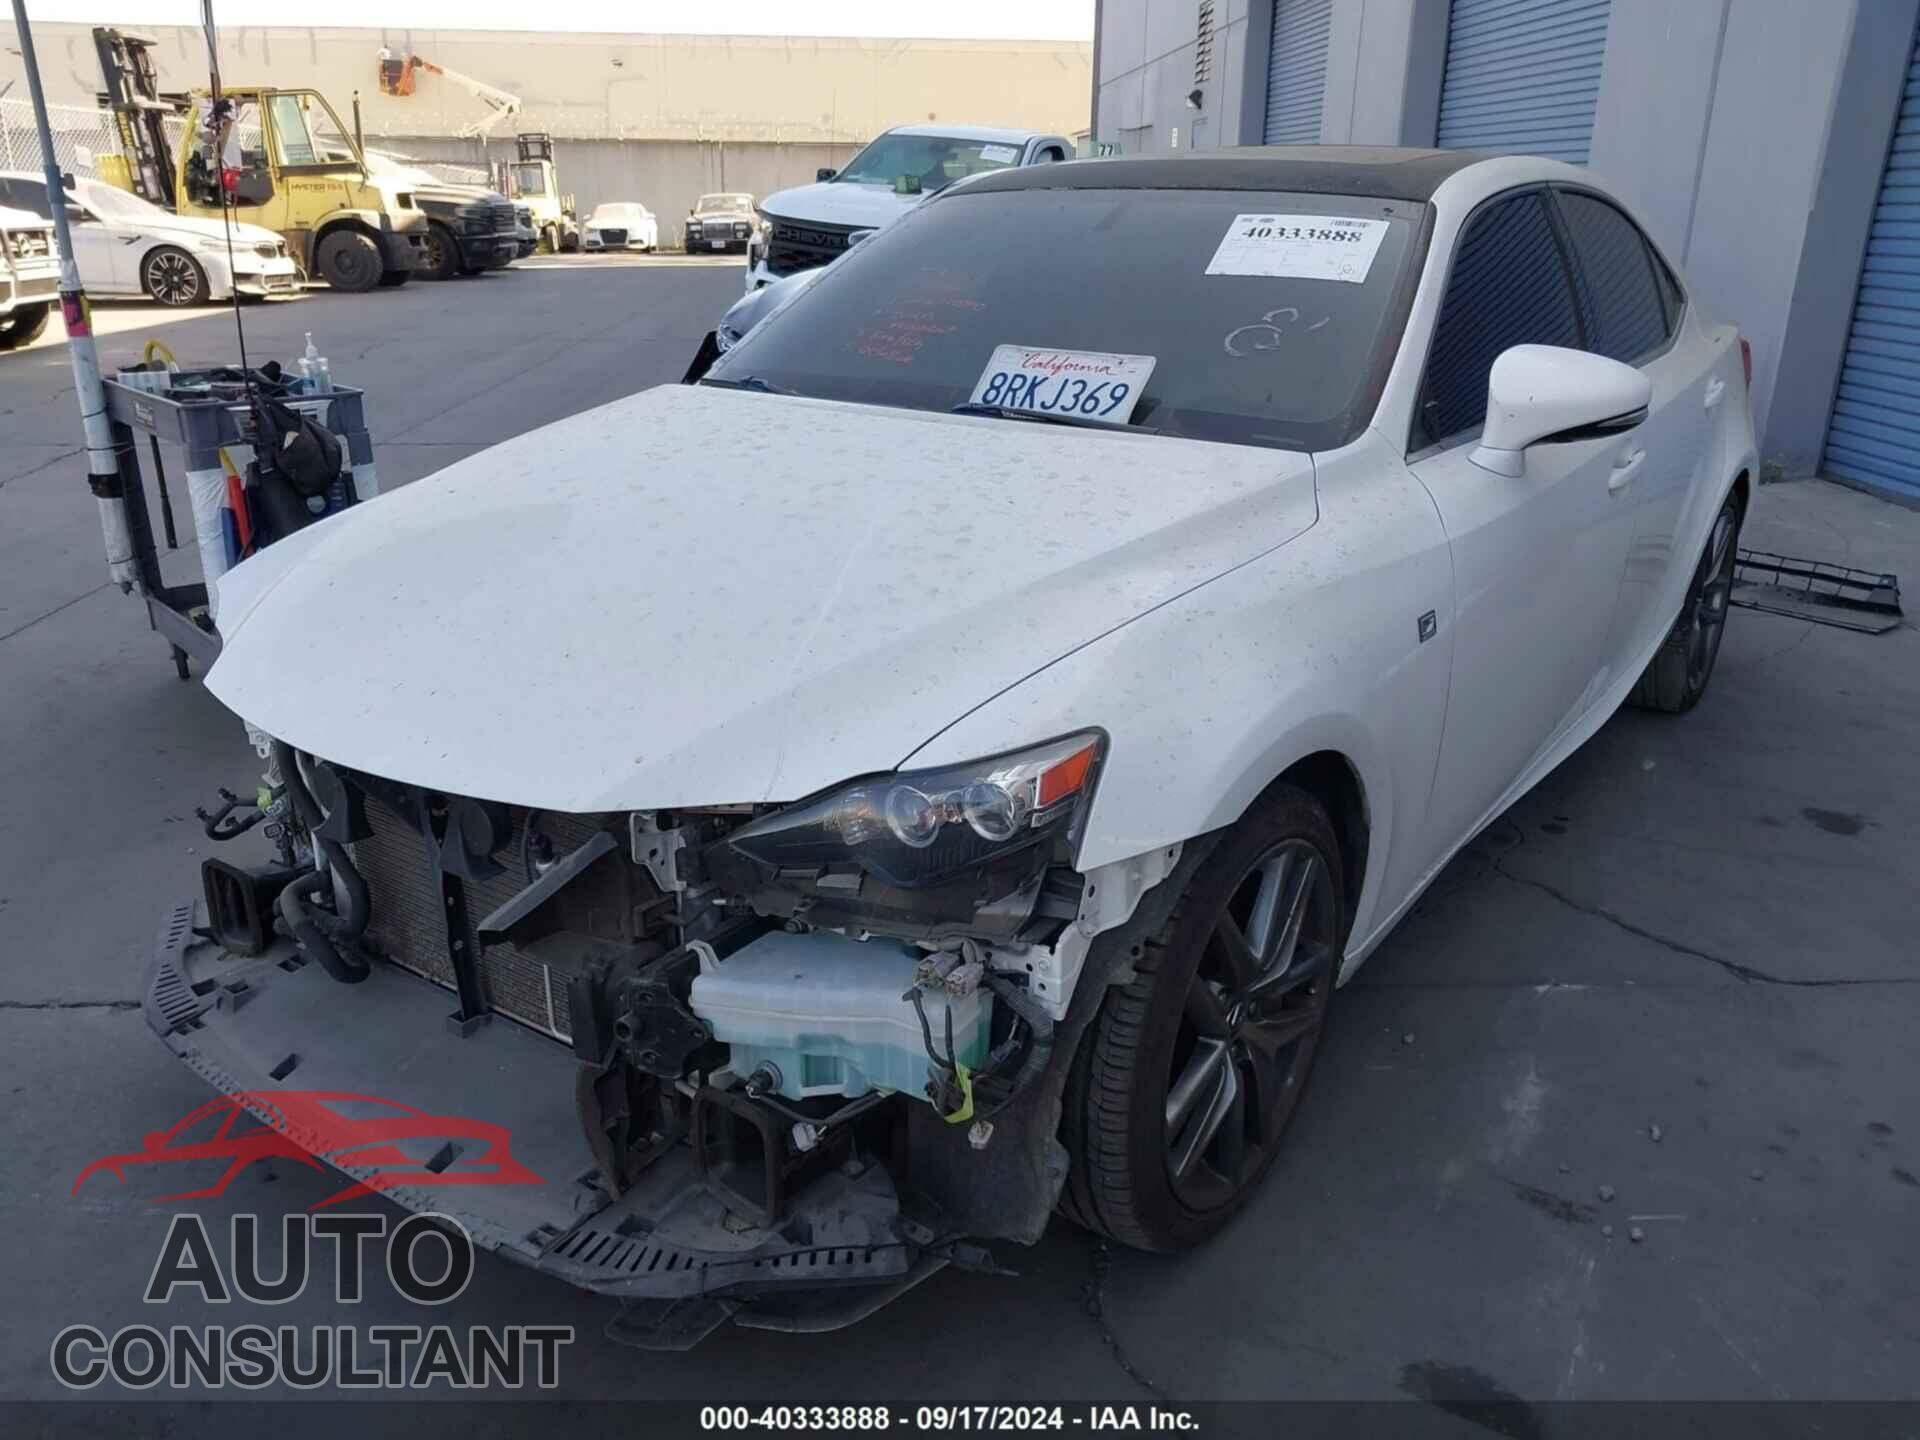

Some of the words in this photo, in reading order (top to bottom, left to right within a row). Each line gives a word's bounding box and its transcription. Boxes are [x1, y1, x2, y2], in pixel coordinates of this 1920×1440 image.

[290, 183, 326, 192] HYSTER
[1242, 226, 1363, 243] 40333888
[1022, 352, 1110, 376] California
[981, 372, 1130, 416] 8RKJ369
